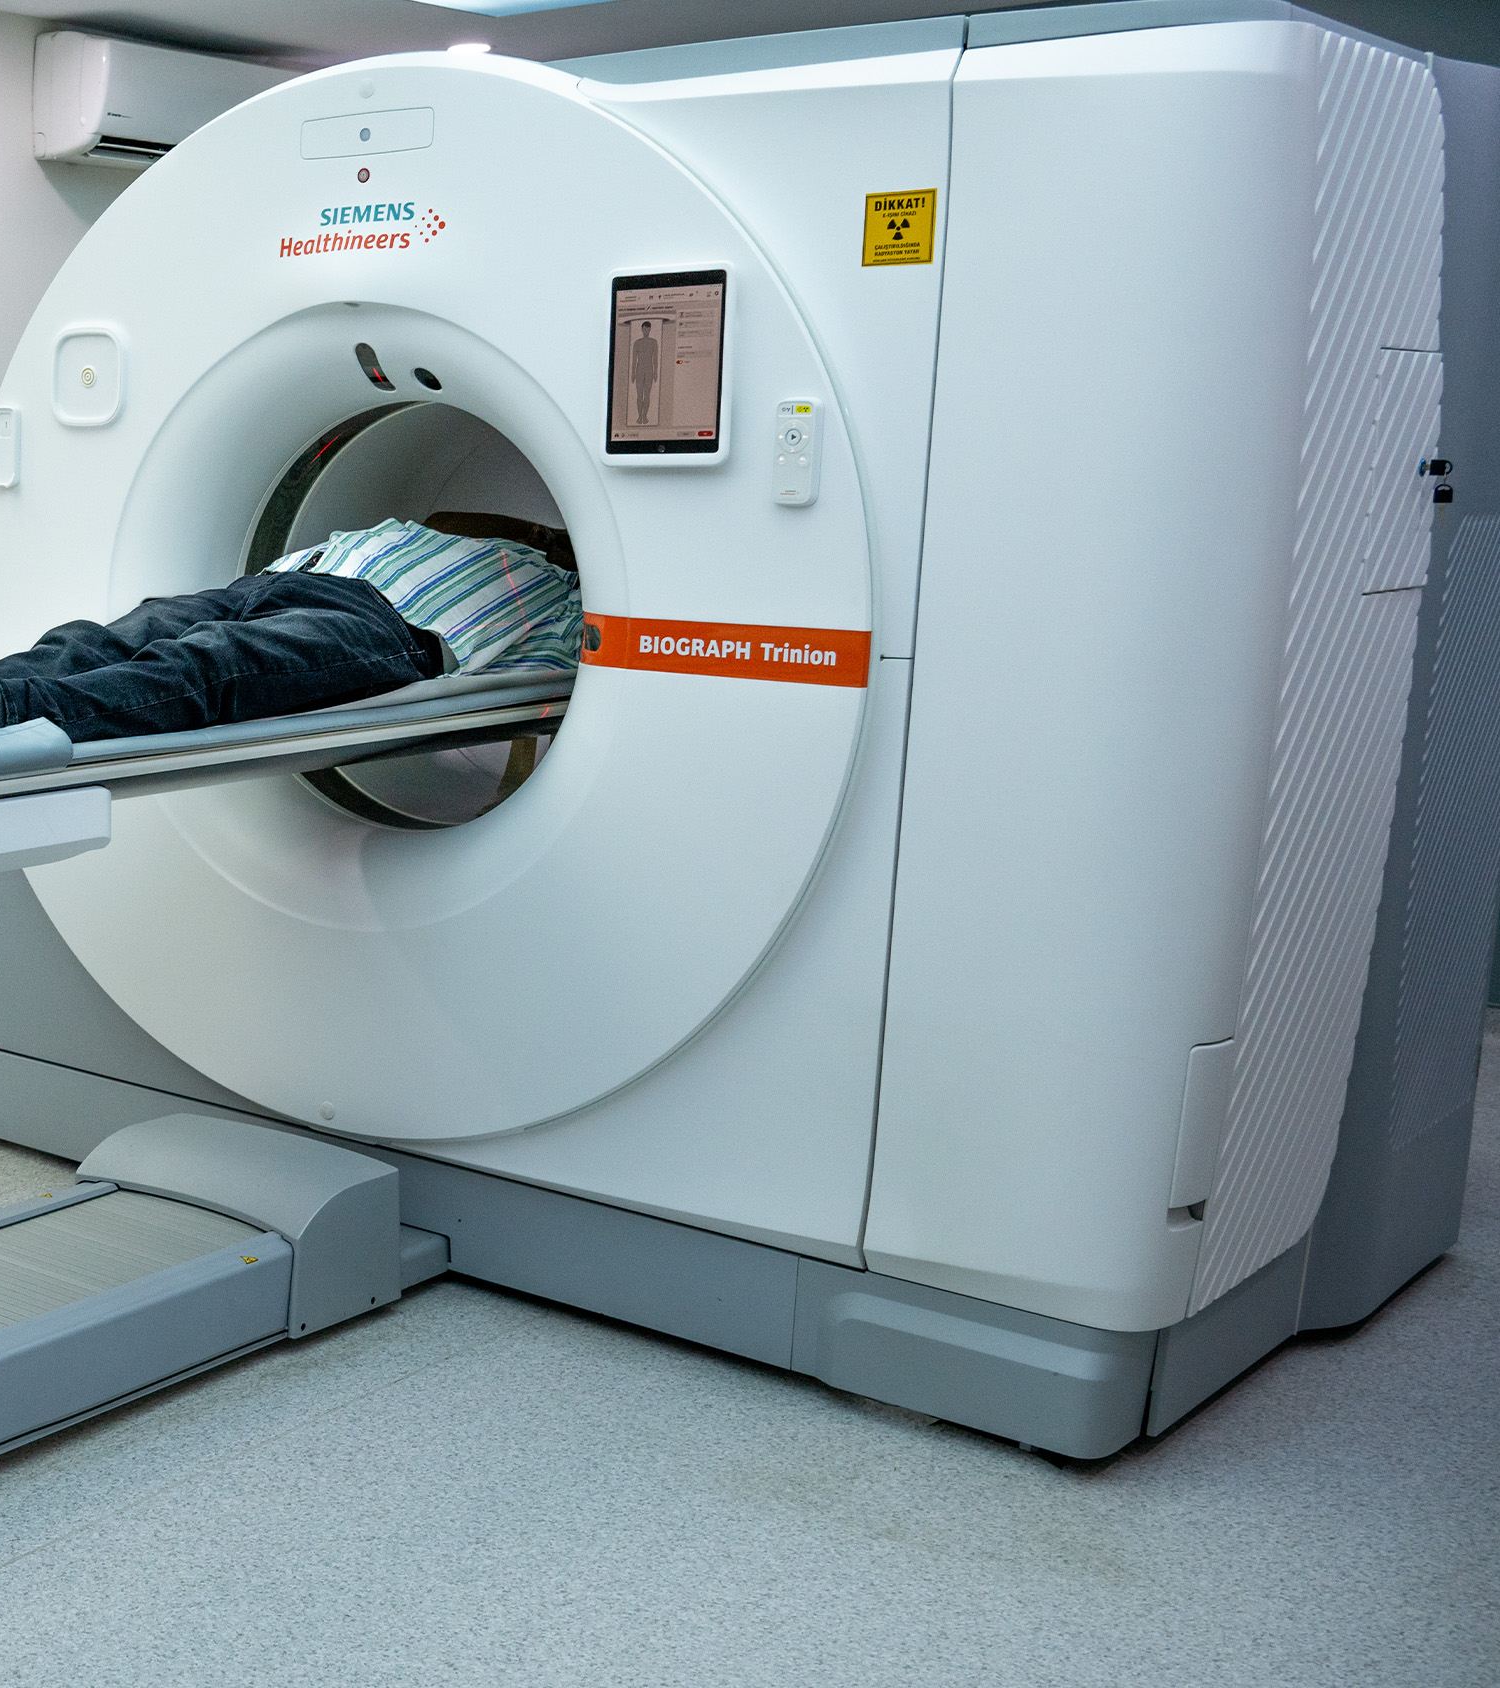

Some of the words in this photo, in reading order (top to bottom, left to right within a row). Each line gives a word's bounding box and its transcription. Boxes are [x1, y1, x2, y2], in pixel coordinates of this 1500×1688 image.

[319, 201, 415, 227] SIEMENS
[874, 197, 926, 211] DİKKAT!
[279, 229, 411, 258] Healthineers
[638, 634, 752, 661] BIOGRAPH
[760, 642, 837, 667] Trinion
